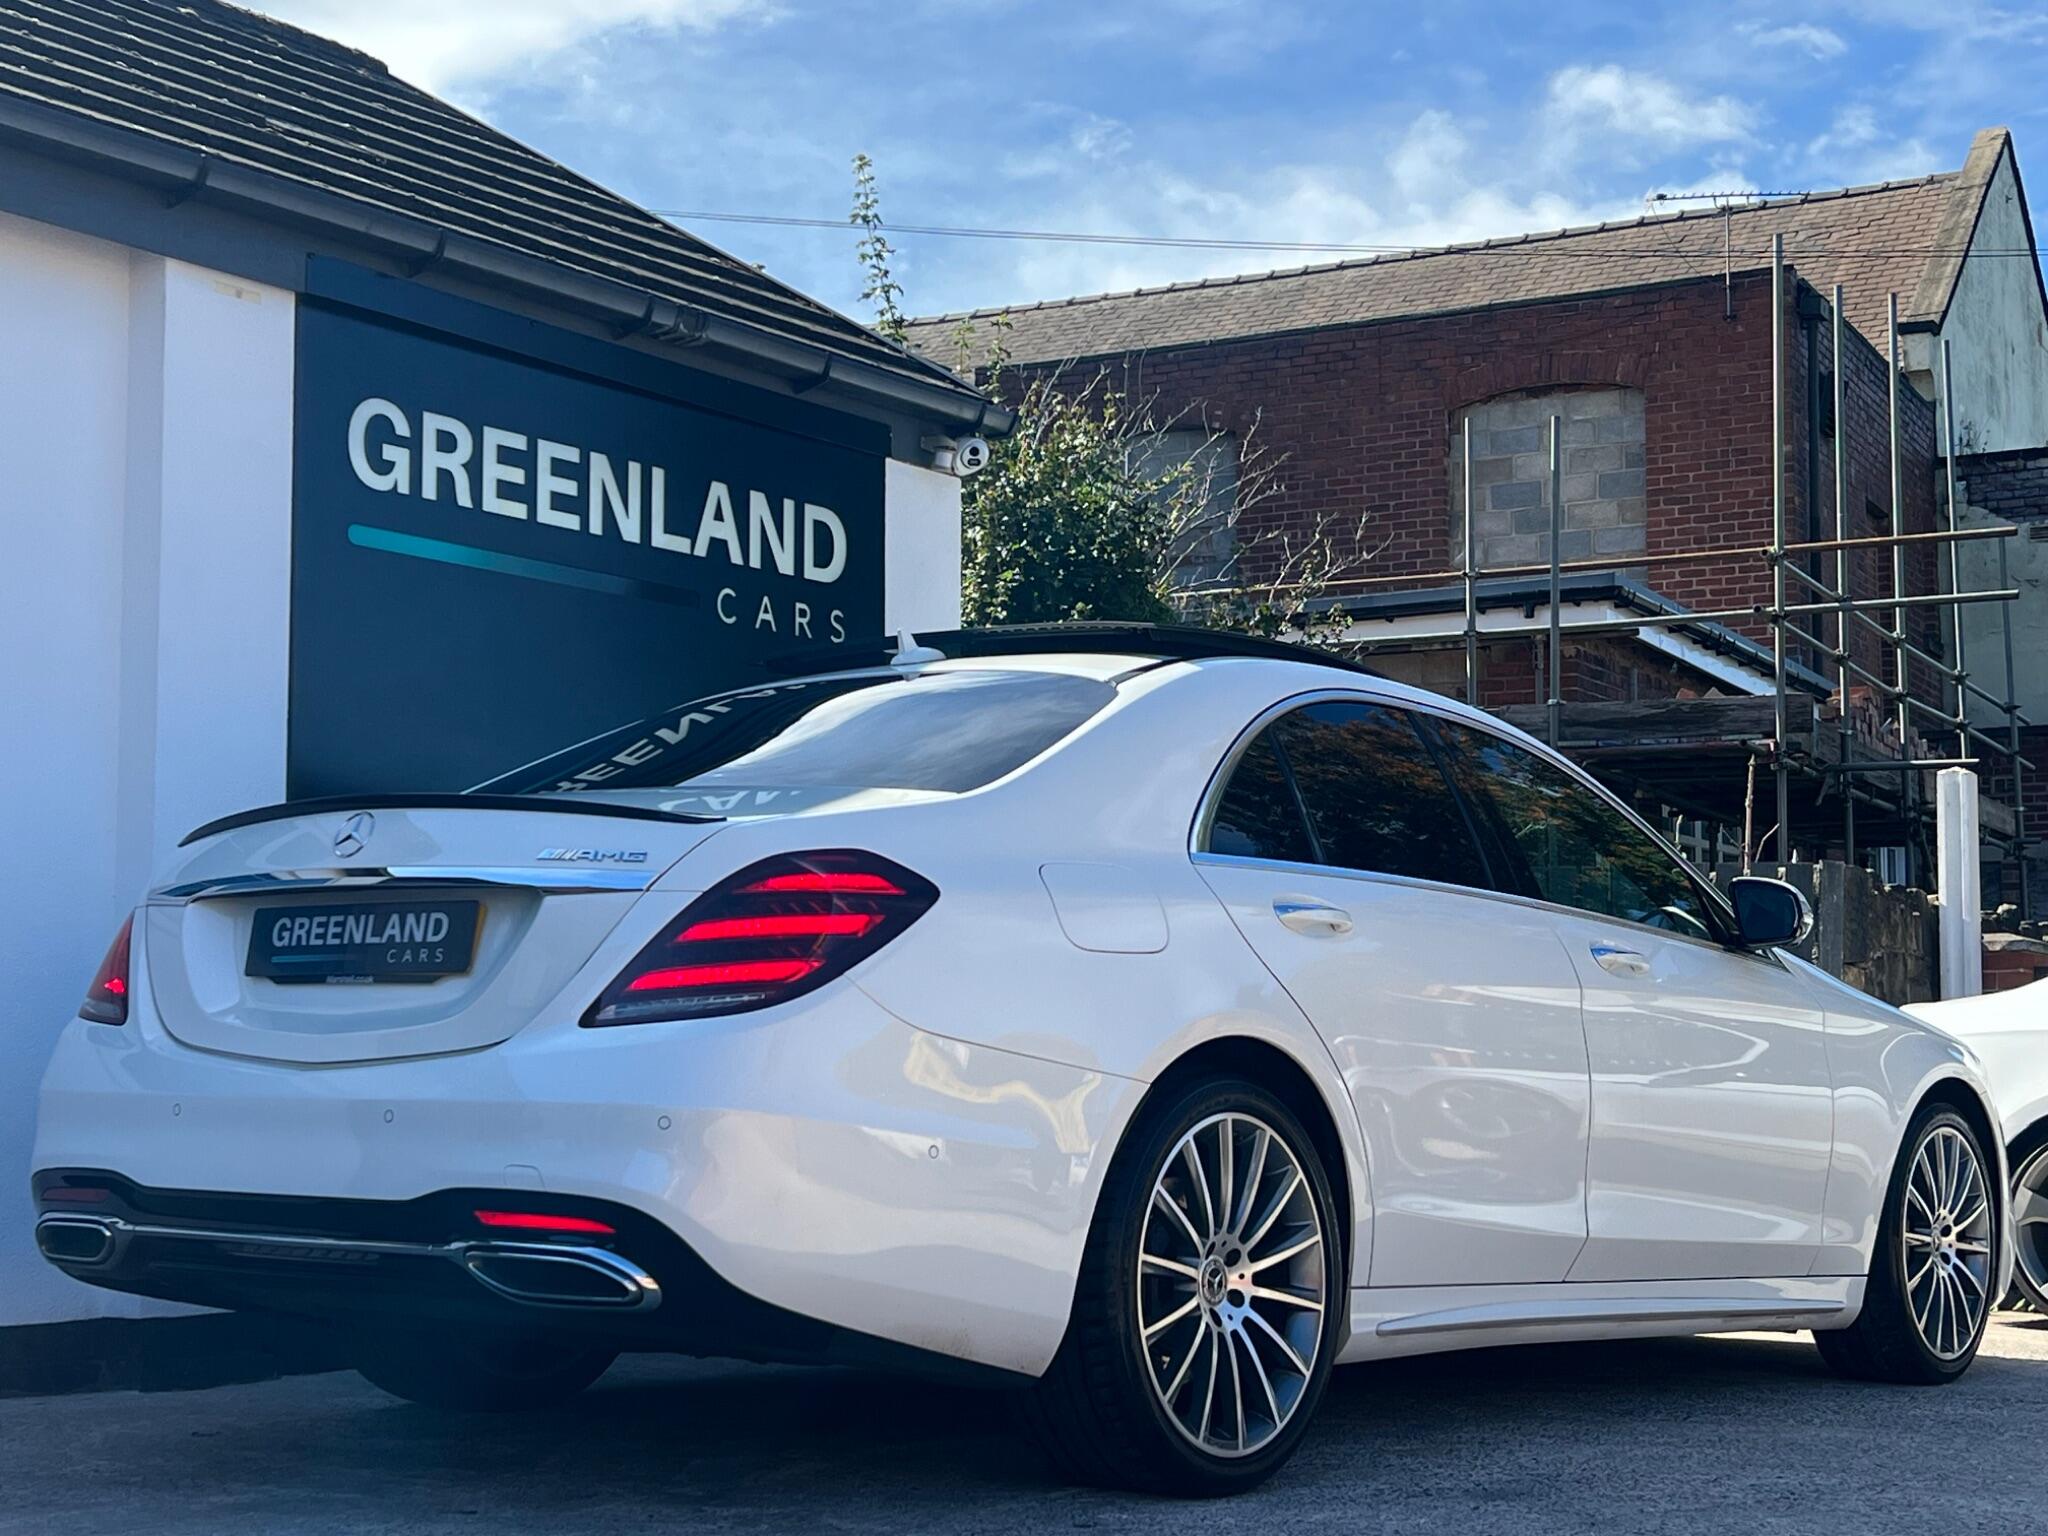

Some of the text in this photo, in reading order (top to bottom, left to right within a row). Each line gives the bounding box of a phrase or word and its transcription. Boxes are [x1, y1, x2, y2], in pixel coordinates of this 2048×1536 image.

[347, 397, 848, 583] GREENLAND
[717, 588, 846, 643] CARS
[572, 848, 648, 862] AMG
[272, 912, 449, 947] GREENLAND
[386, 948, 444, 963] CARS
